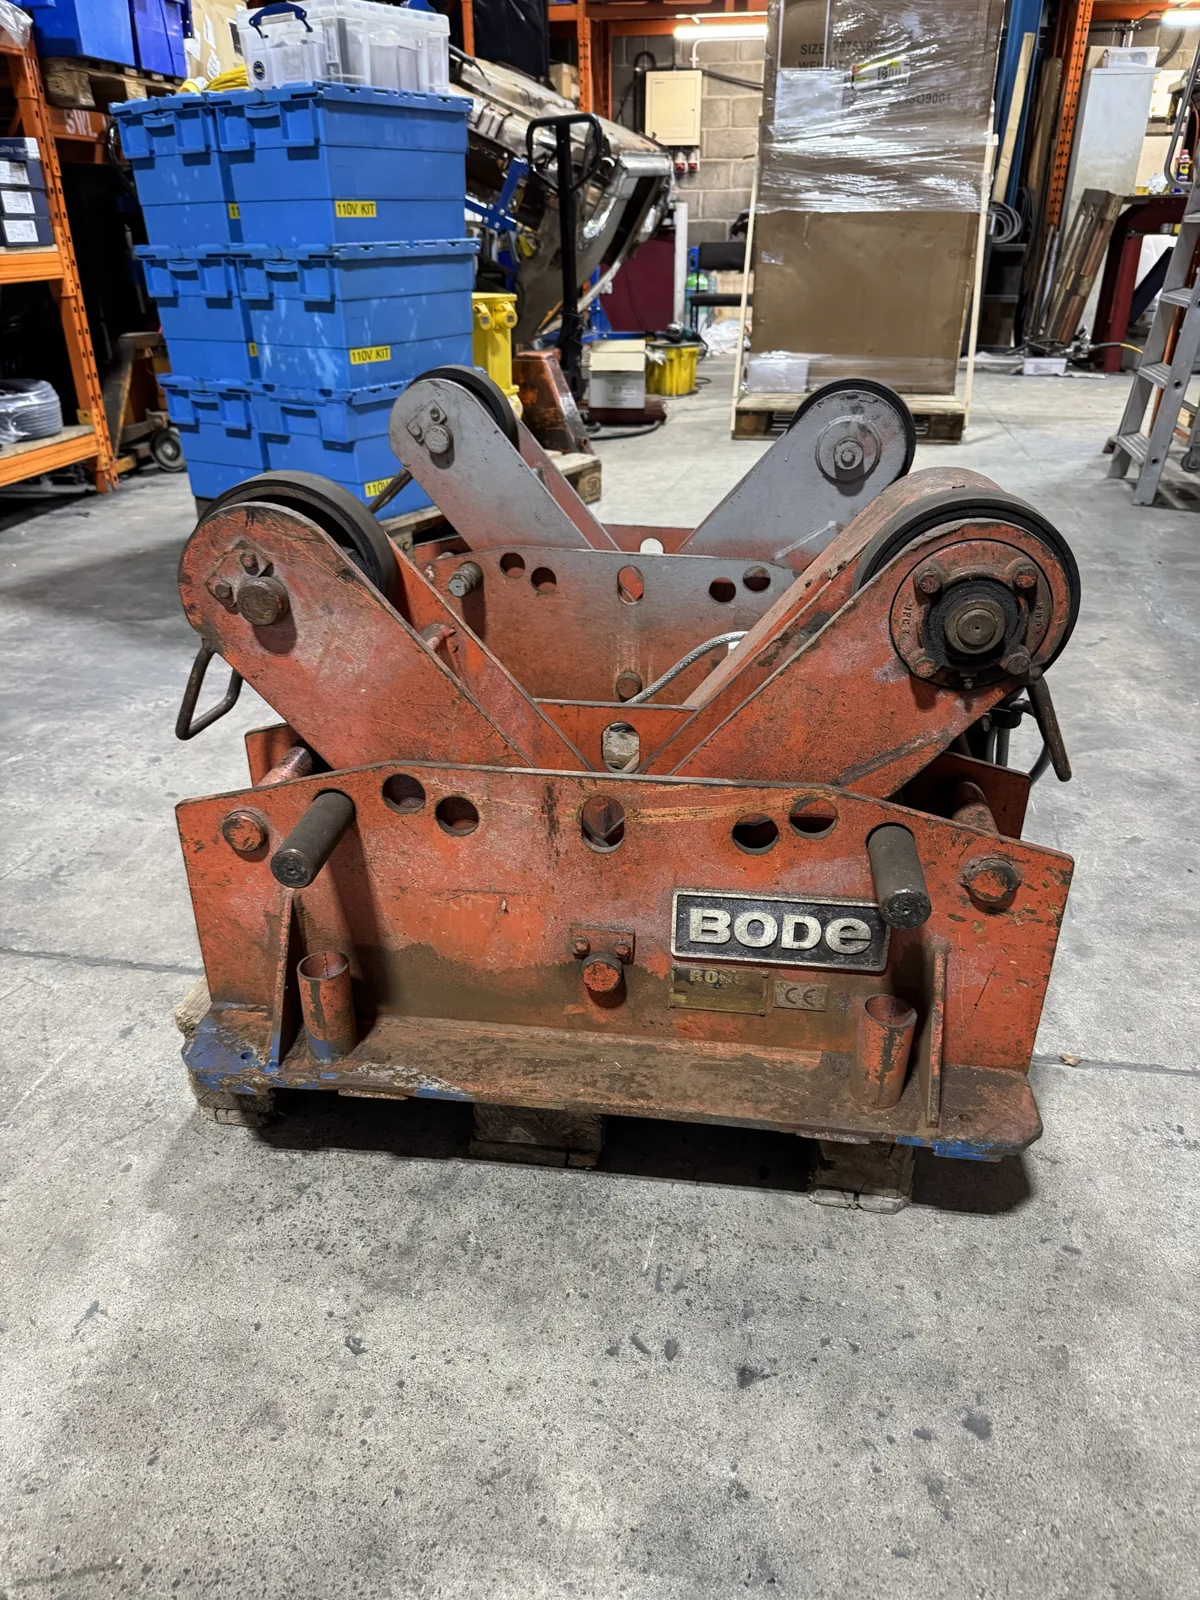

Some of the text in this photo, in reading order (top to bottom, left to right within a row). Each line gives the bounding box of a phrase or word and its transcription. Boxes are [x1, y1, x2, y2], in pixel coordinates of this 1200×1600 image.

[65, 109, 98, 138] SWL
[337, 203, 375, 215] 110V KIT
[352, 347, 390, 362] 110V KIT
